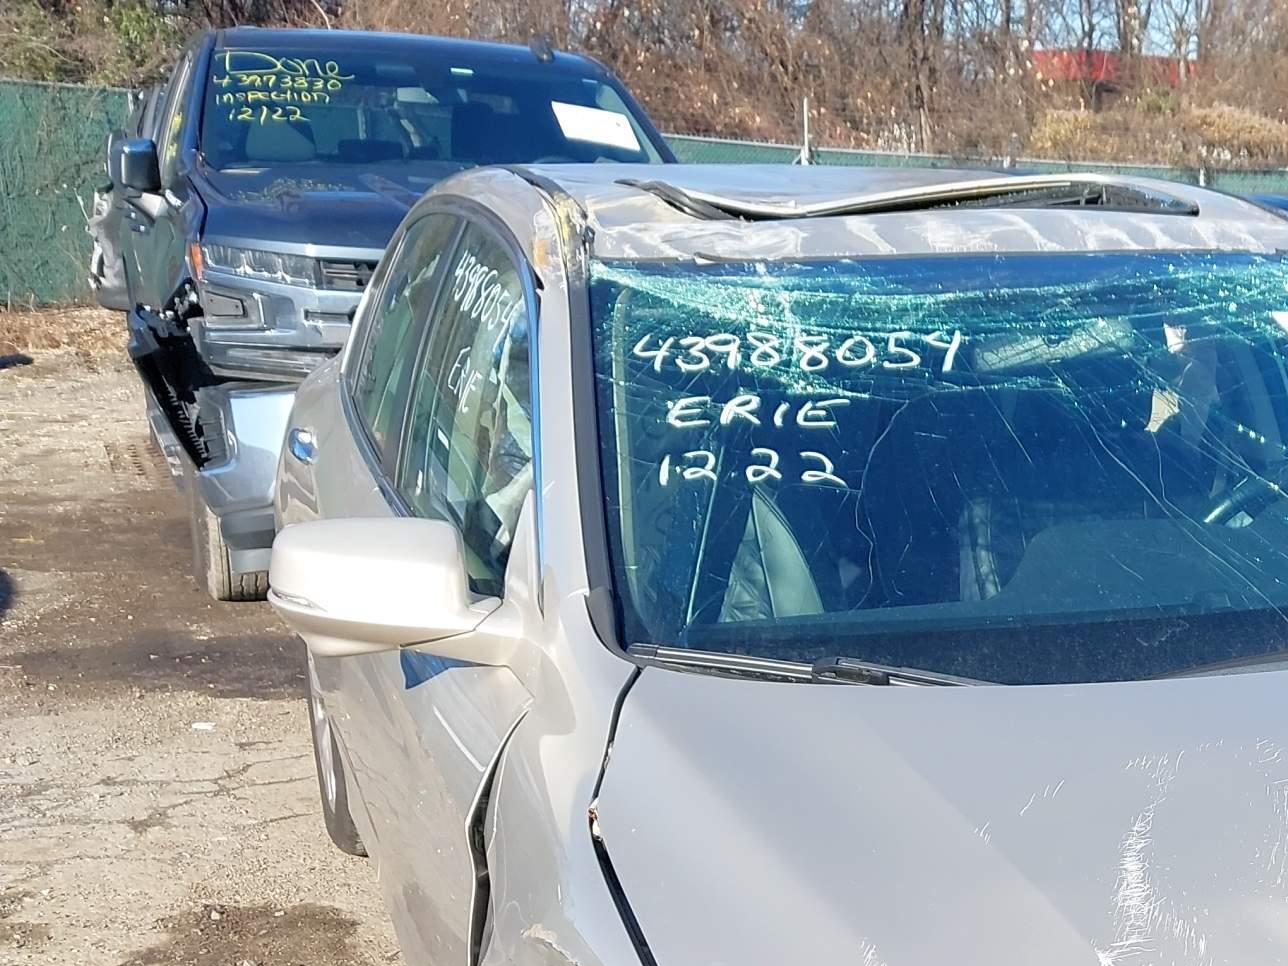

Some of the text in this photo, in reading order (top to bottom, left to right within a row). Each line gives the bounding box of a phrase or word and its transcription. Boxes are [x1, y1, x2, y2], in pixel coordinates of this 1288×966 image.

[214, 50, 355, 80] Done
[229, 105, 311, 126] 12/22
[633, 329, 961, 373] 43988054
[666, 394, 850, 428] ERIE
